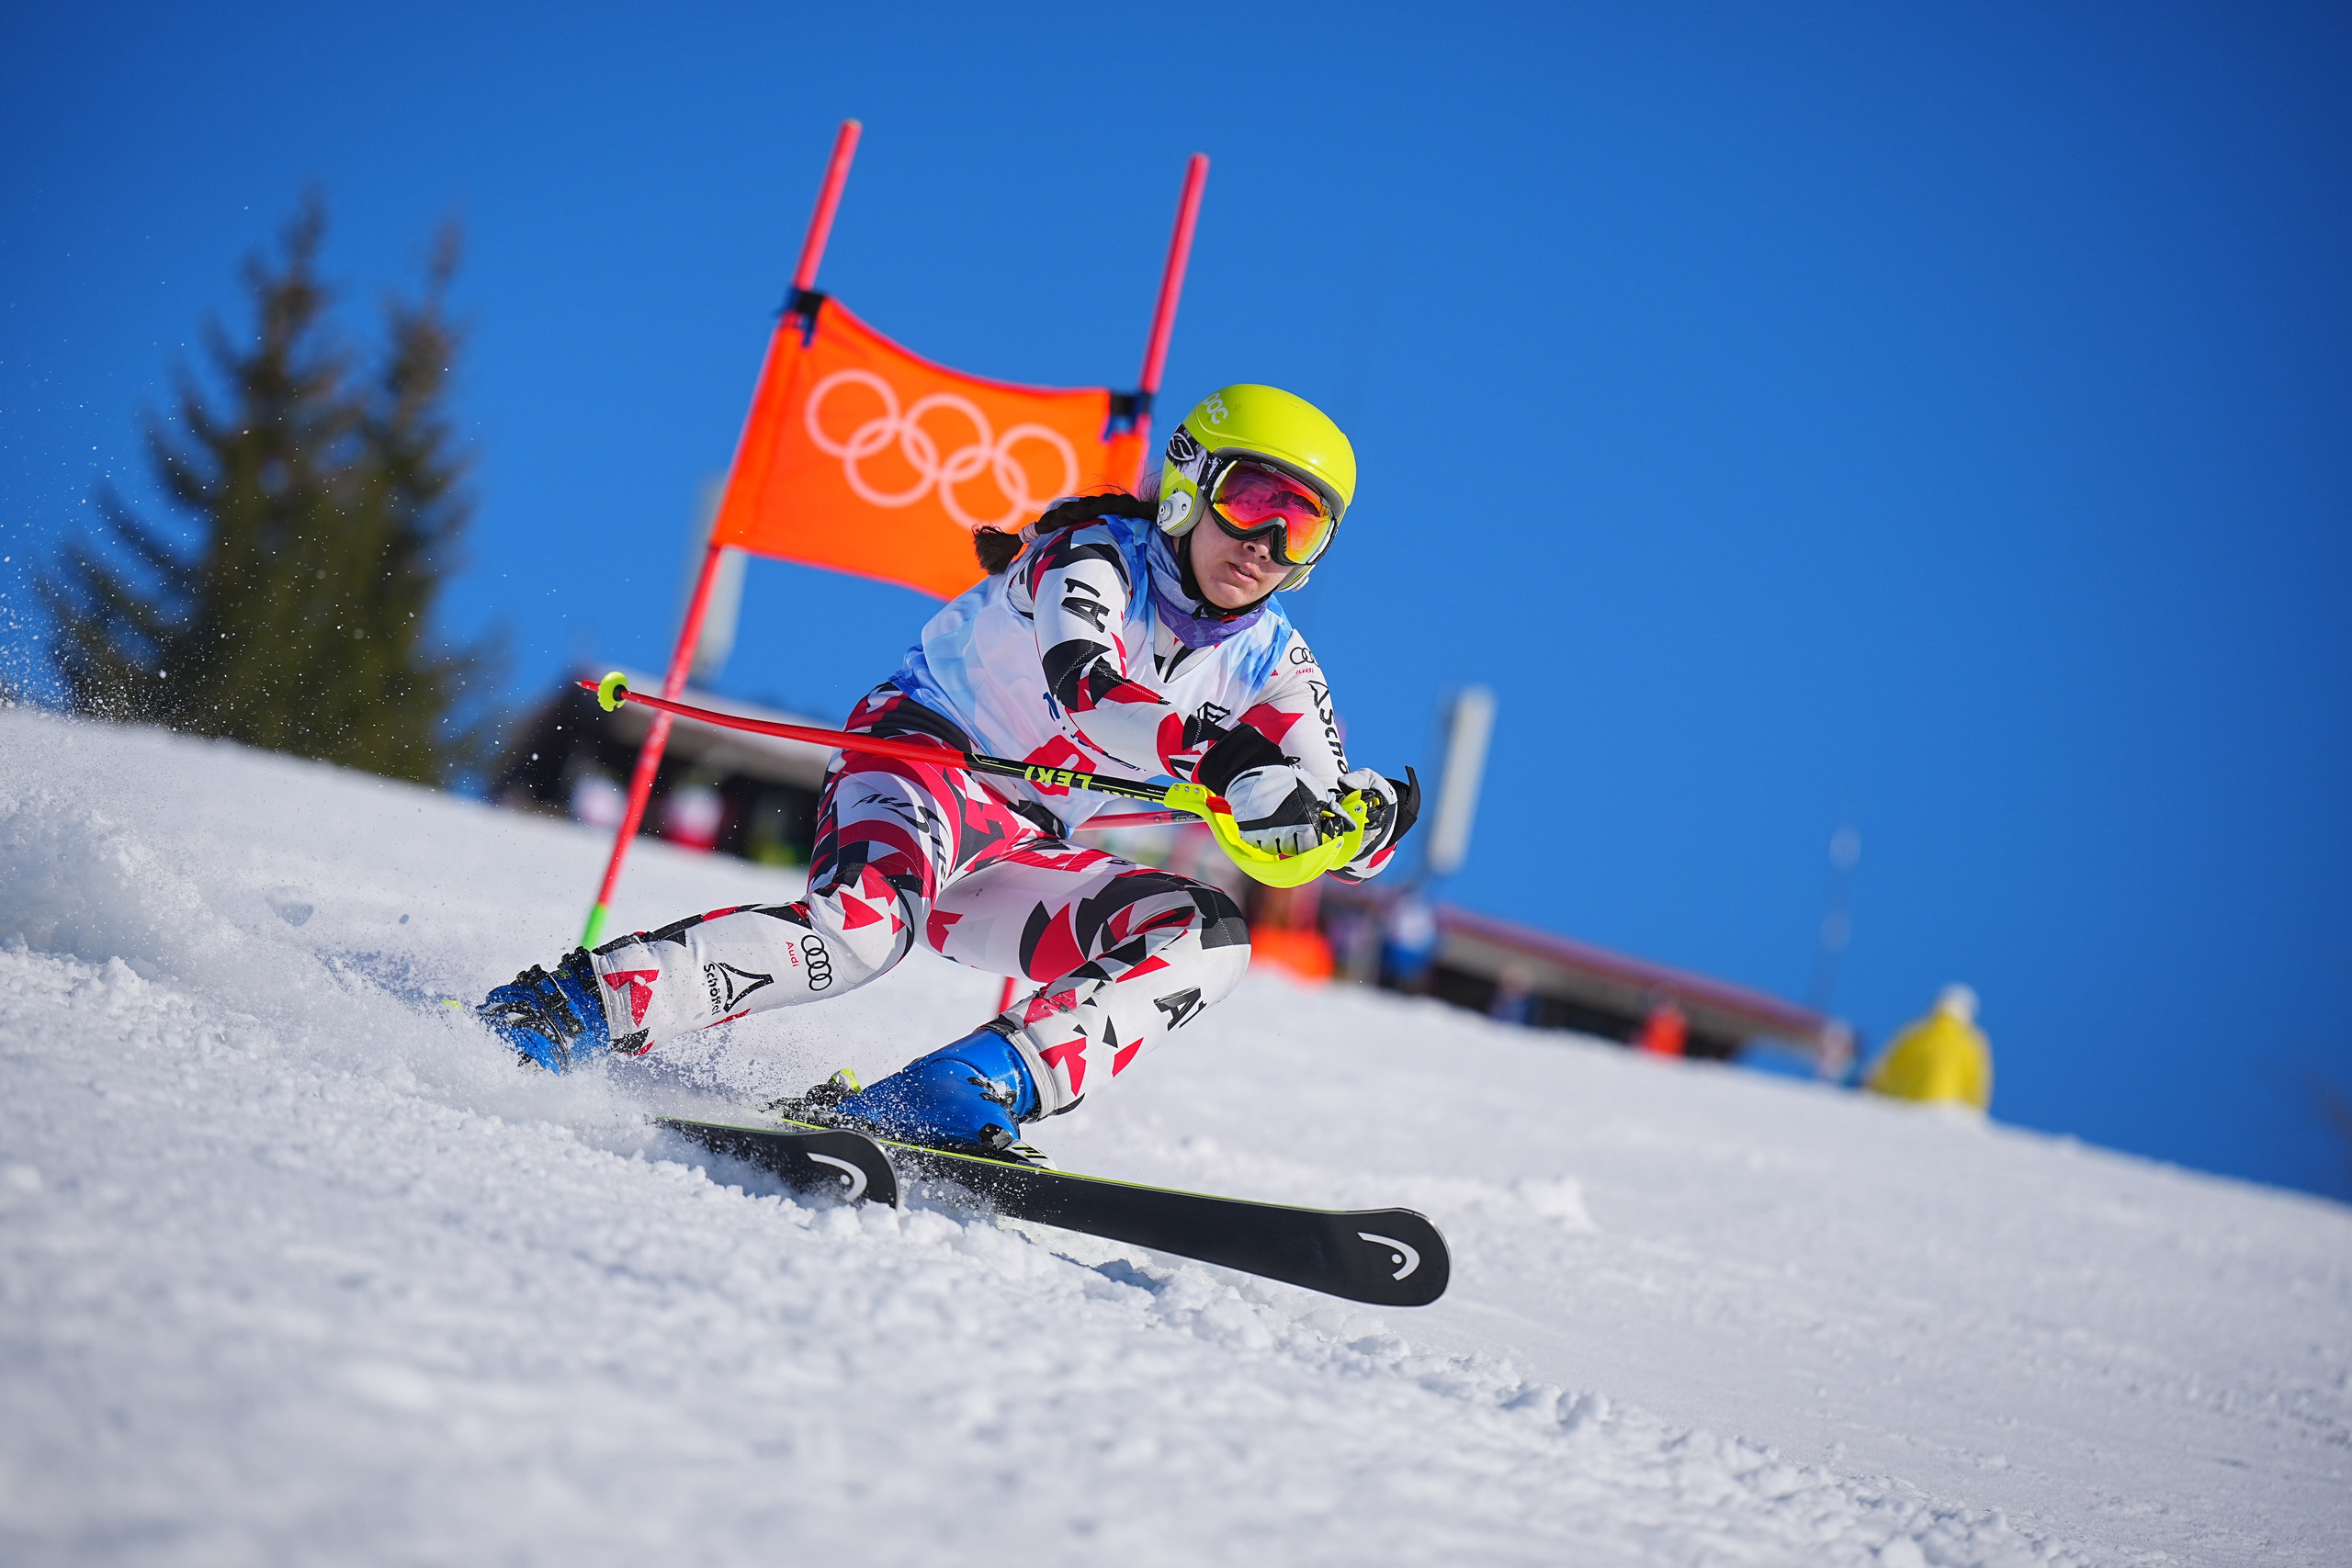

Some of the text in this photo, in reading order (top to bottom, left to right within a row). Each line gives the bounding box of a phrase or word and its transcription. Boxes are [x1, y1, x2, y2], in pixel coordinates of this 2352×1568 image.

[1060, 577, 1111, 634] A1
[1023, 765, 1093, 791] LEKI
[786, 941, 800, 967] Audi
